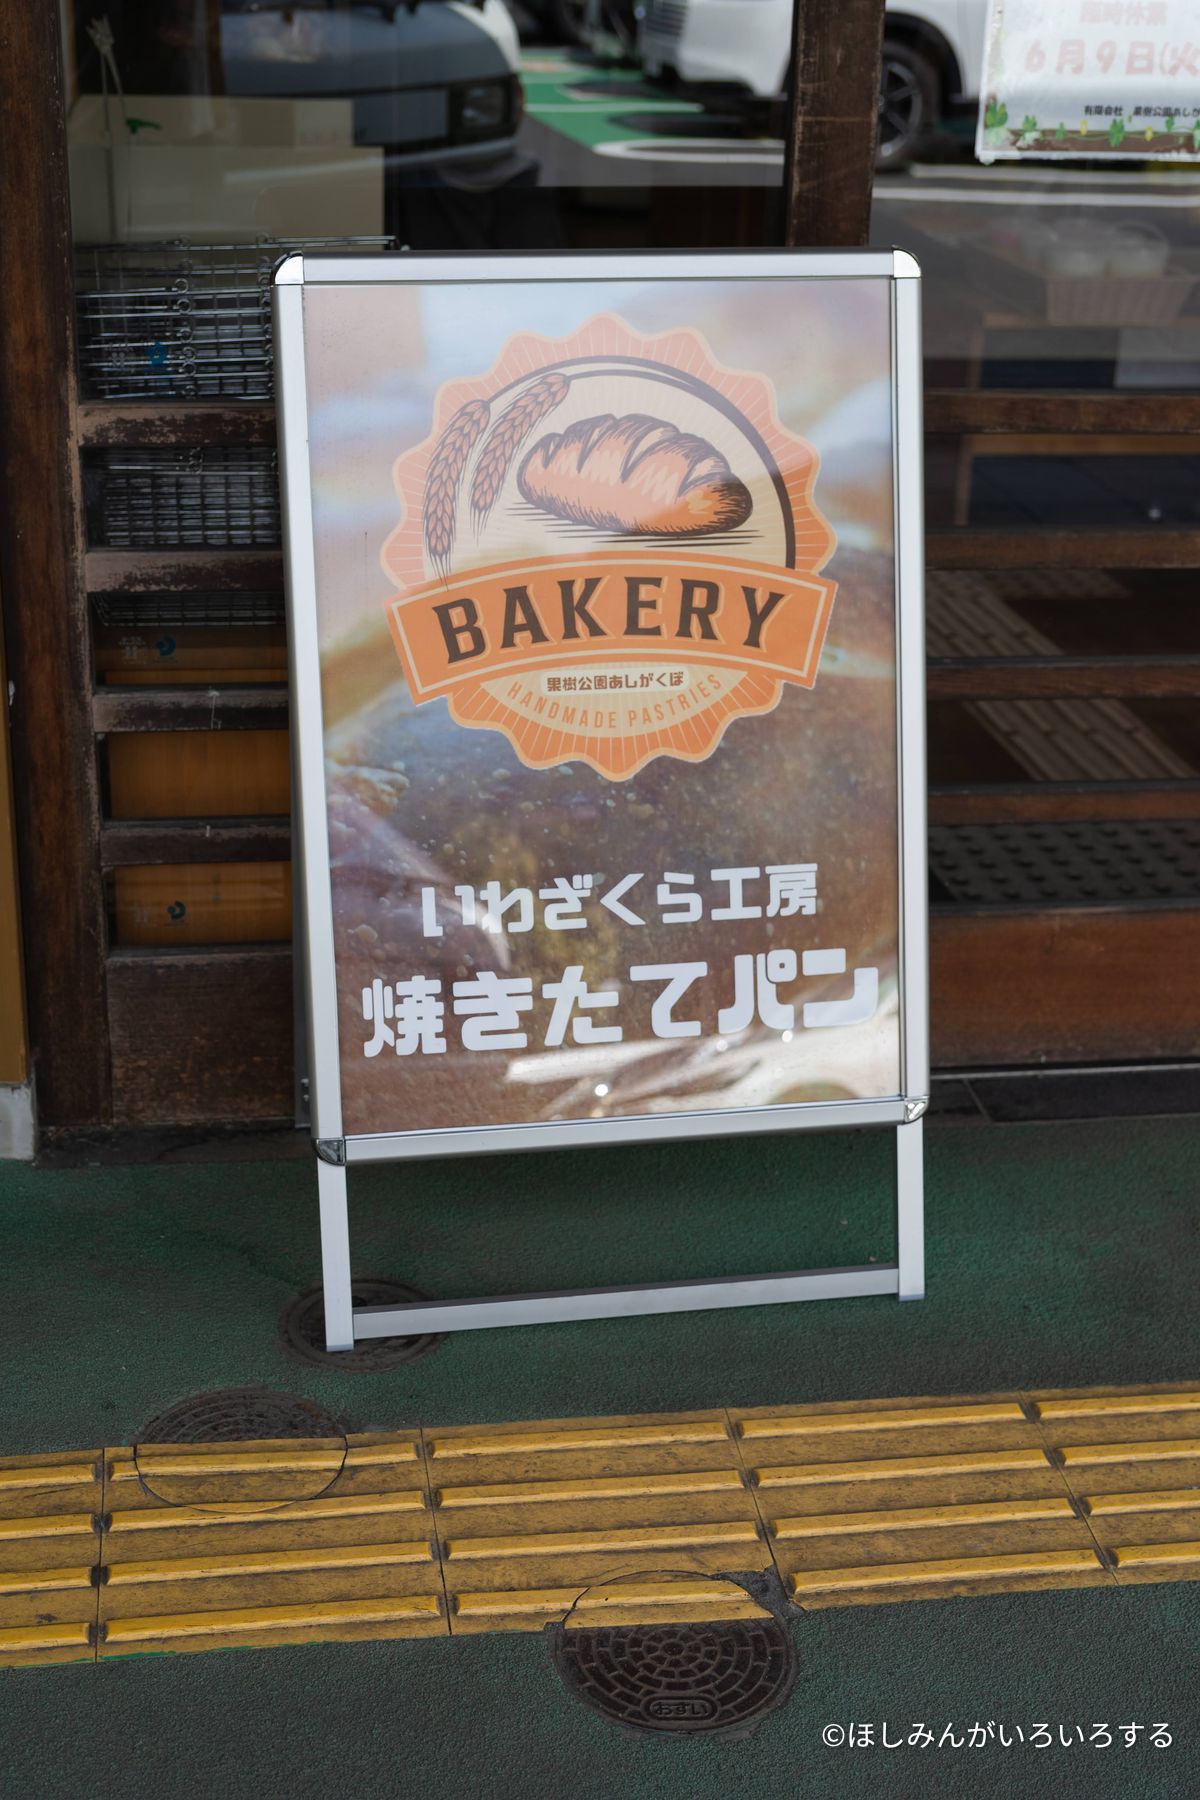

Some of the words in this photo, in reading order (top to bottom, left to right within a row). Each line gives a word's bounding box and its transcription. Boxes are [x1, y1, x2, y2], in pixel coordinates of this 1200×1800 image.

[432, 576, 788, 665] BAKERY
[507, 681, 617, 728] HANDMADE
[628, 674, 722, 728] PASTRIES
[547, 671, 684, 692] 果樹公園あしがくぼ
[422, 863, 818, 937] いわざくら工房
[362, 948, 879, 1058] 焼きたてパン
[651, 1701, 709, 1716] おすい
